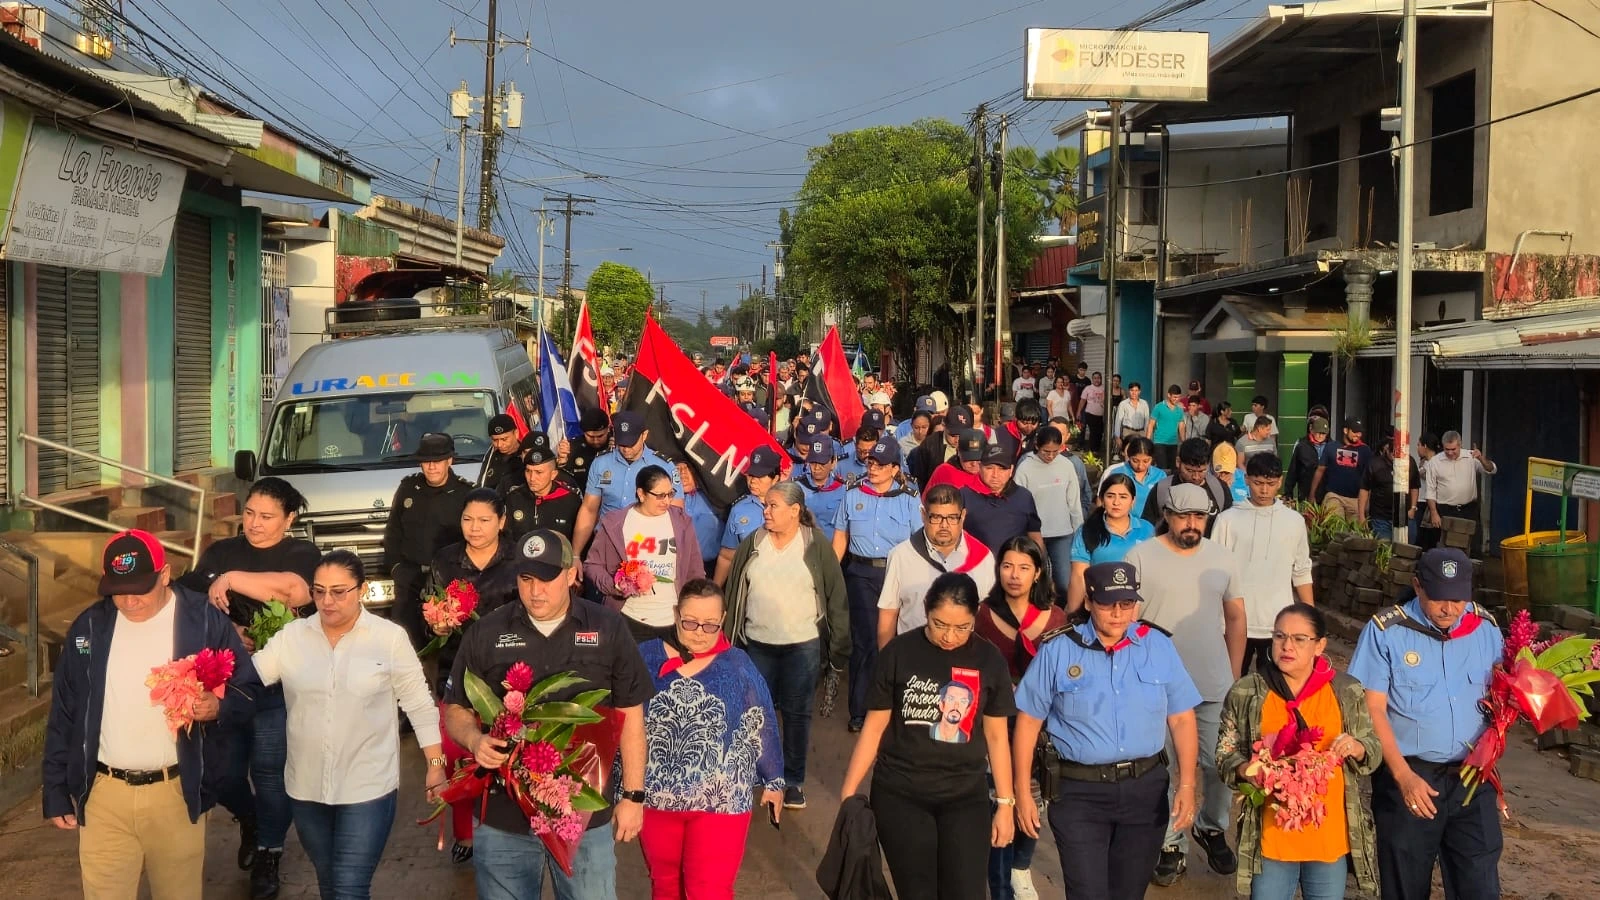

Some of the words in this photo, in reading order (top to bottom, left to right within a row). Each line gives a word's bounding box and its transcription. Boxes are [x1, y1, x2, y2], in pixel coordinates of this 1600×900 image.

[1079, 51, 1185, 70] FUNDESER
[57, 133, 91, 185] La
[92, 145, 162, 201] Fuente
[25, 200, 60, 224] Medicina
[23, 221, 56, 242] Oriental
[292, 371, 481, 395] URACCAN
[645, 377, 749, 488] FSLN
[907, 675, 939, 693] Carlos
[903, 688, 941, 705] Fonseca
[901, 702, 940, 721] Amador
